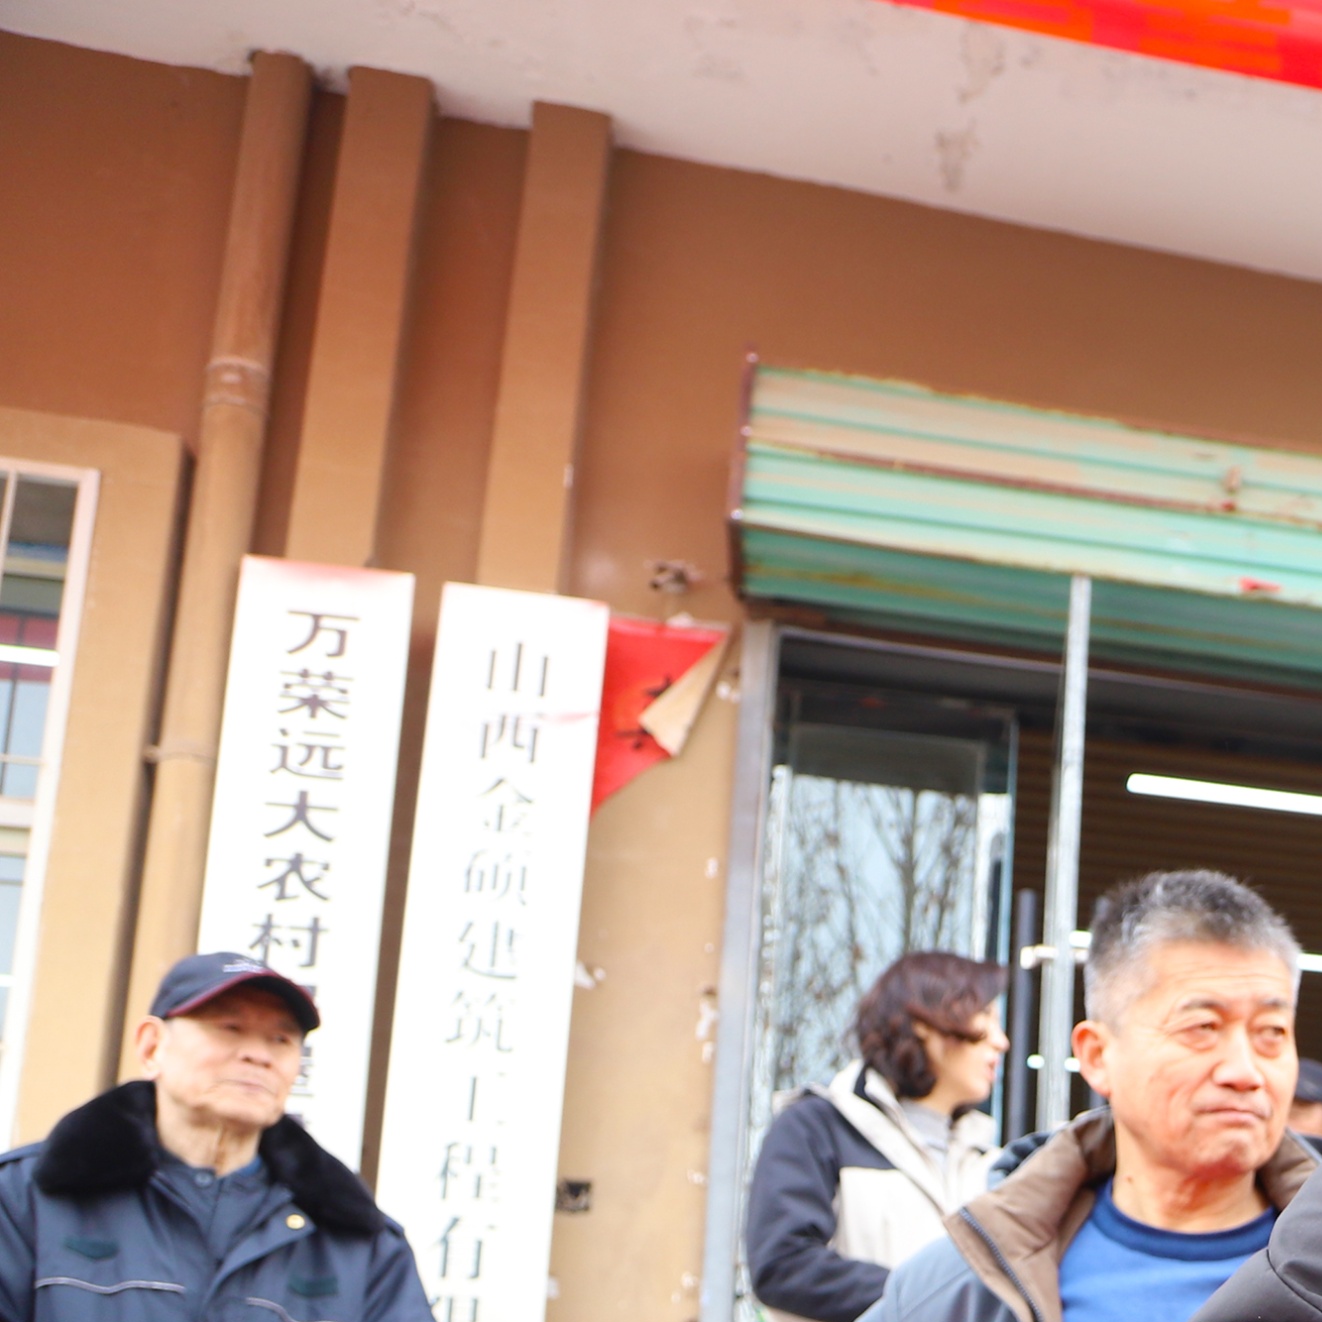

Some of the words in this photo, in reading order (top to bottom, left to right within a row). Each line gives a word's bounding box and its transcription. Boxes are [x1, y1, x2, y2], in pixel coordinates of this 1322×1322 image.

[248, 608, 361, 1130] 万荣远大农村
